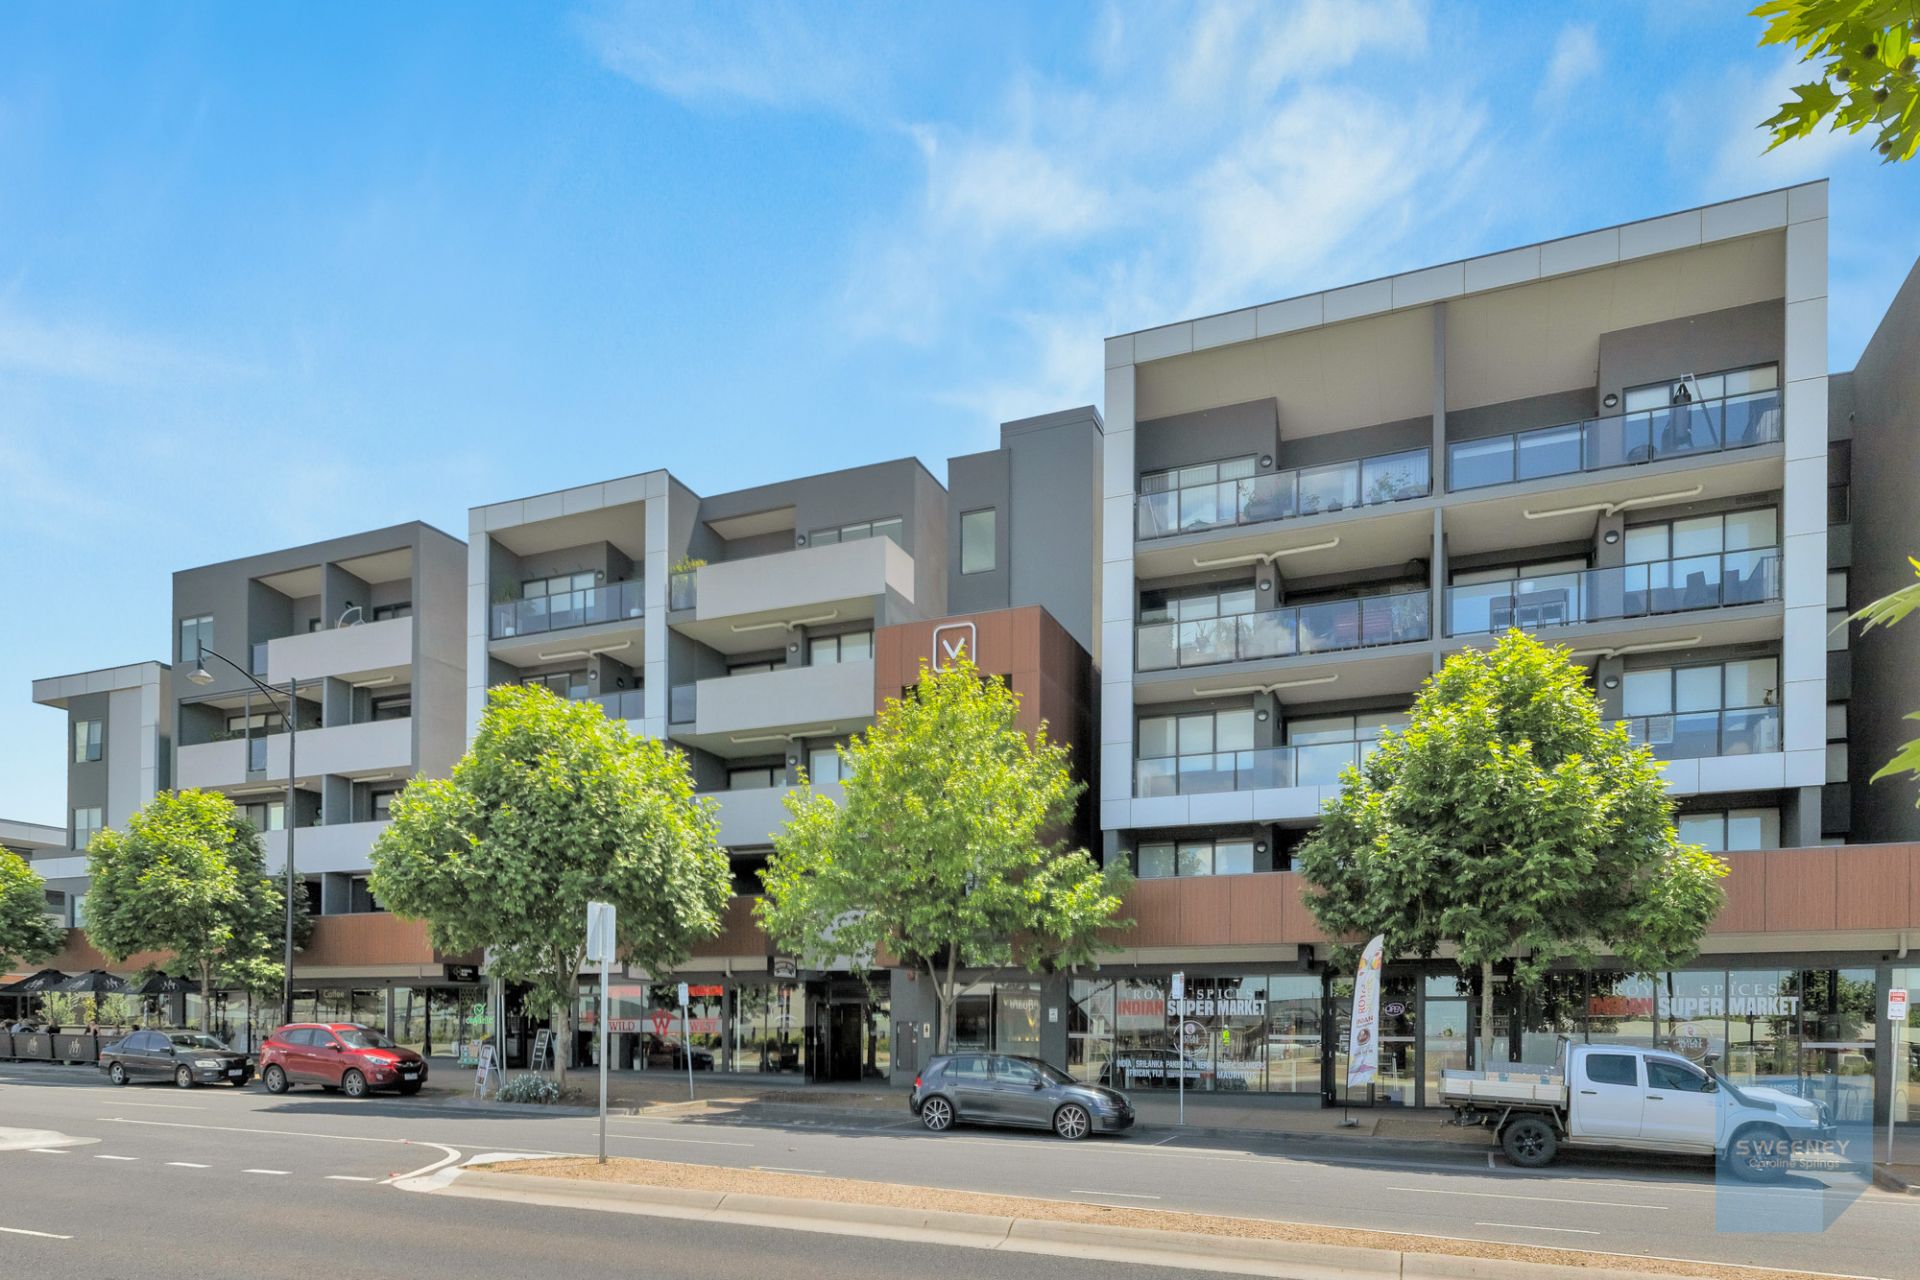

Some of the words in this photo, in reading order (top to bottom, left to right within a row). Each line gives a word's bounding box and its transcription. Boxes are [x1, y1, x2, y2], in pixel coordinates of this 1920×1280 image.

[323, 989, 345, 998] Coffee
[1700, 984, 1778, 996] SPICES
[1118, 1000, 1164, 1016] INDIAN
[1167, 1000, 1214, 1016] SUPER
[1217, 1000, 1267, 1016] MARKET
[1658, 997, 1724, 1016] SUPER
[1728, 997, 1799, 1016] MARKET
[608, 1021, 636, 1031] WILD
[689, 1021, 717, 1032] WEST
